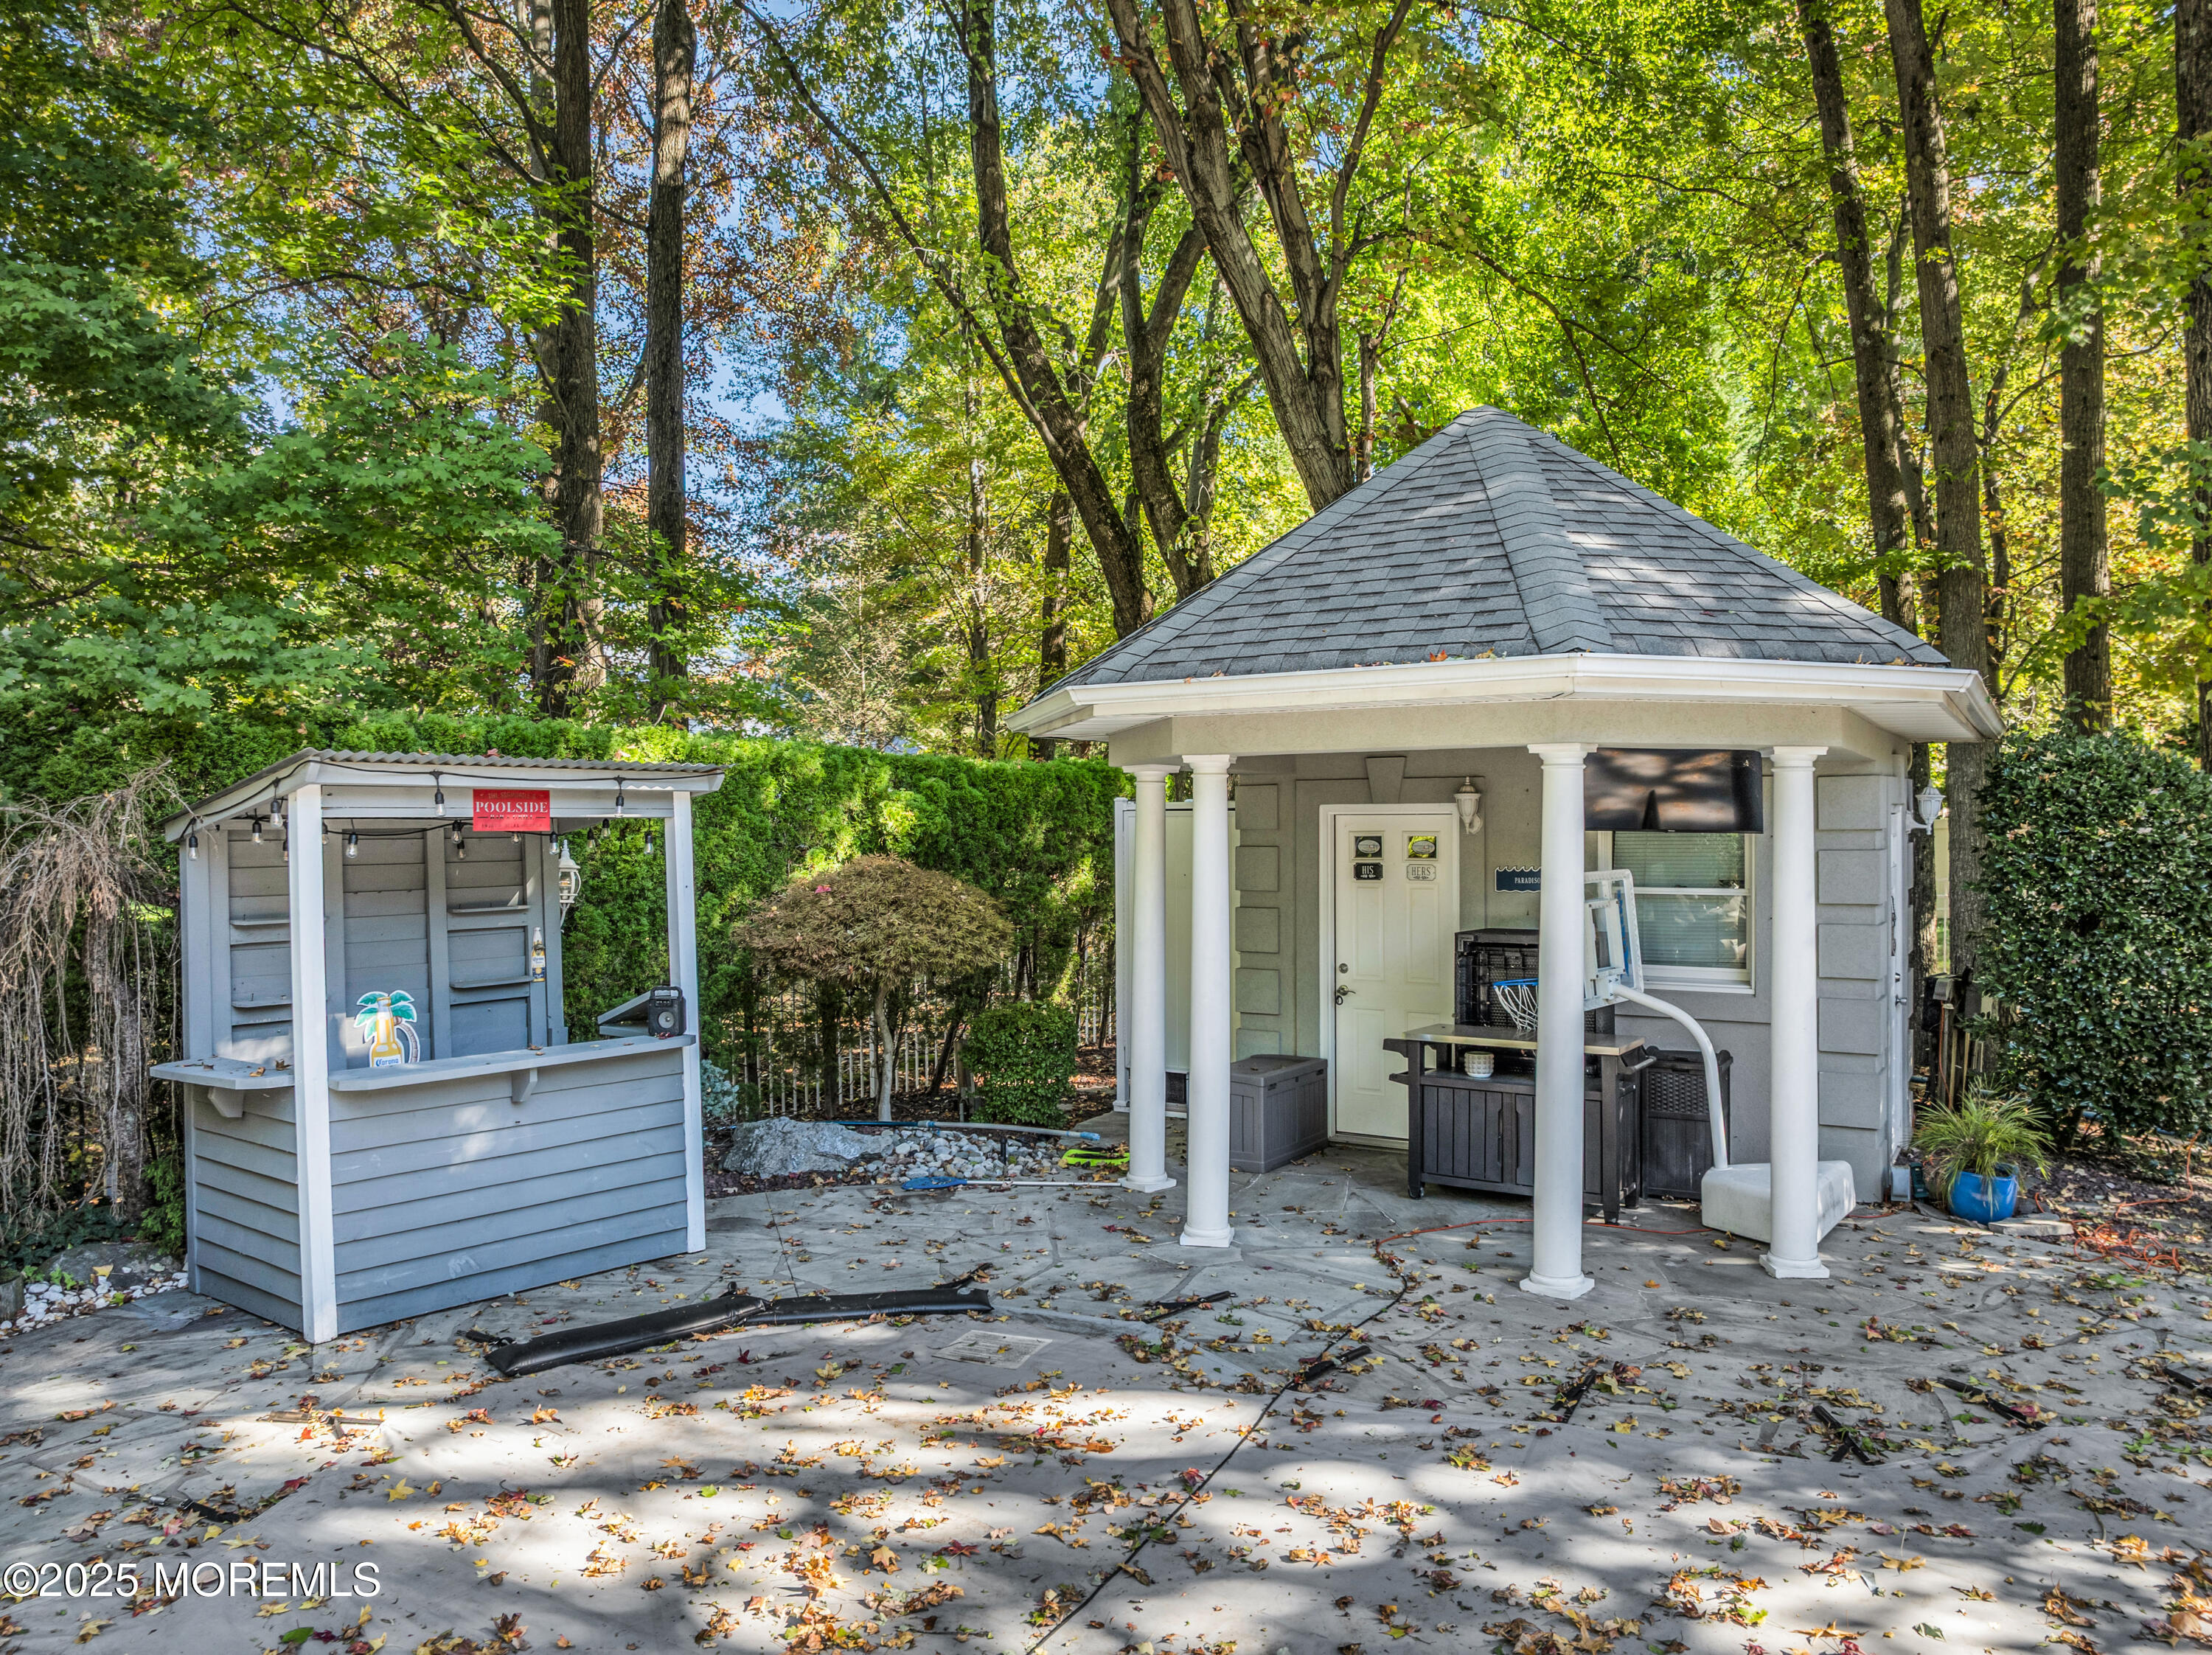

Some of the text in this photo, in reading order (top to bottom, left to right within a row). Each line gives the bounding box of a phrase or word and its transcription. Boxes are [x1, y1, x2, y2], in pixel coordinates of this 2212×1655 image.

[476, 801, 548, 813] POOLSIDE
[1362, 865, 1374, 874] HIS
[1411, 866, 1431, 876] HERS
[375, 1059, 399, 1067] Corona
